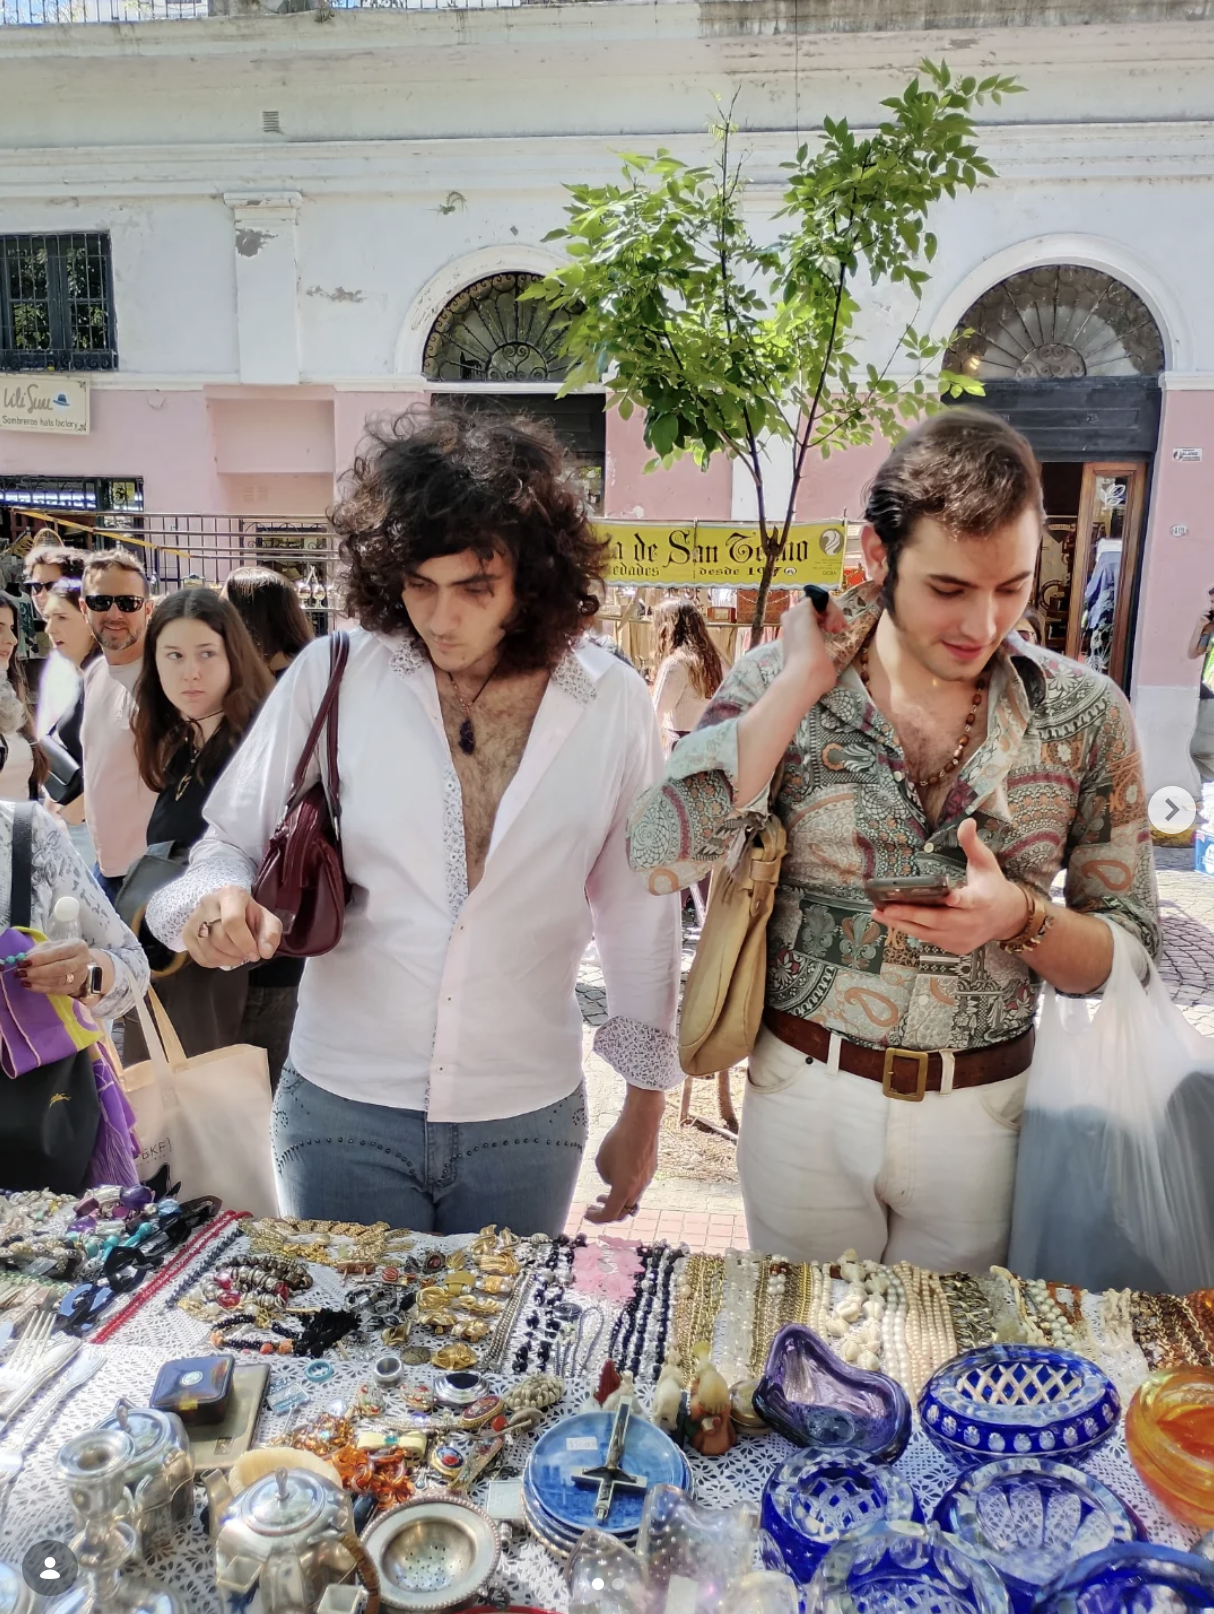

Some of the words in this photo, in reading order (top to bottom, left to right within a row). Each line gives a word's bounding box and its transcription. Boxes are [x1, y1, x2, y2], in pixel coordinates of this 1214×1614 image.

[2, 415, 38, 426] Sombreros
[40, 417, 54, 427] hats
[55, 418, 78, 430] factory
[634, 532, 658, 562] de
[662, 529, 719, 568] San
[699, 566, 740, 576] desde
